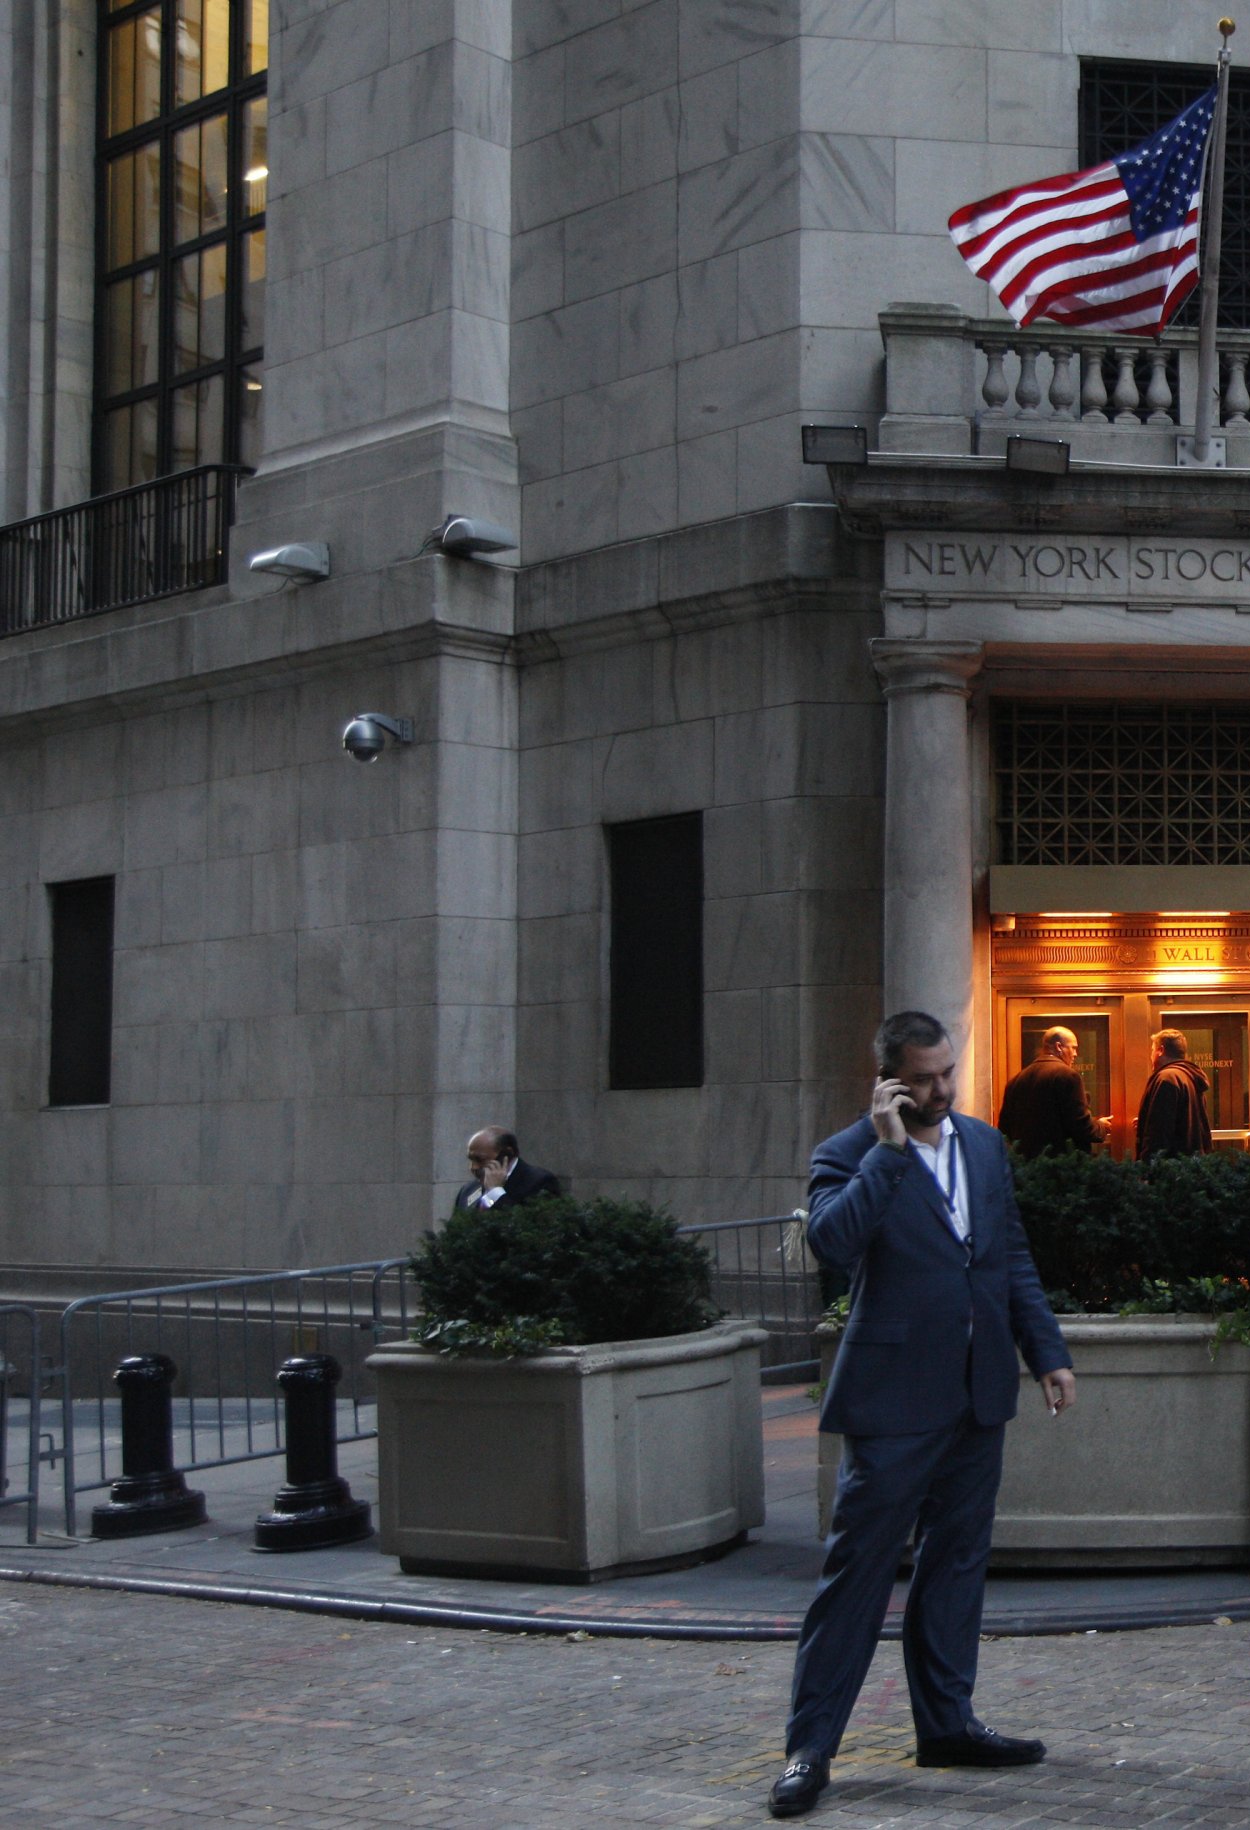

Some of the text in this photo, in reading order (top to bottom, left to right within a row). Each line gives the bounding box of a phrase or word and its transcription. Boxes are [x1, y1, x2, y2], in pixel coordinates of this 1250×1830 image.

[903, 542, 1000, 577] NEW
[1010, 544, 1121, 582] YORK
[1163, 947, 1216, 961] WALL
